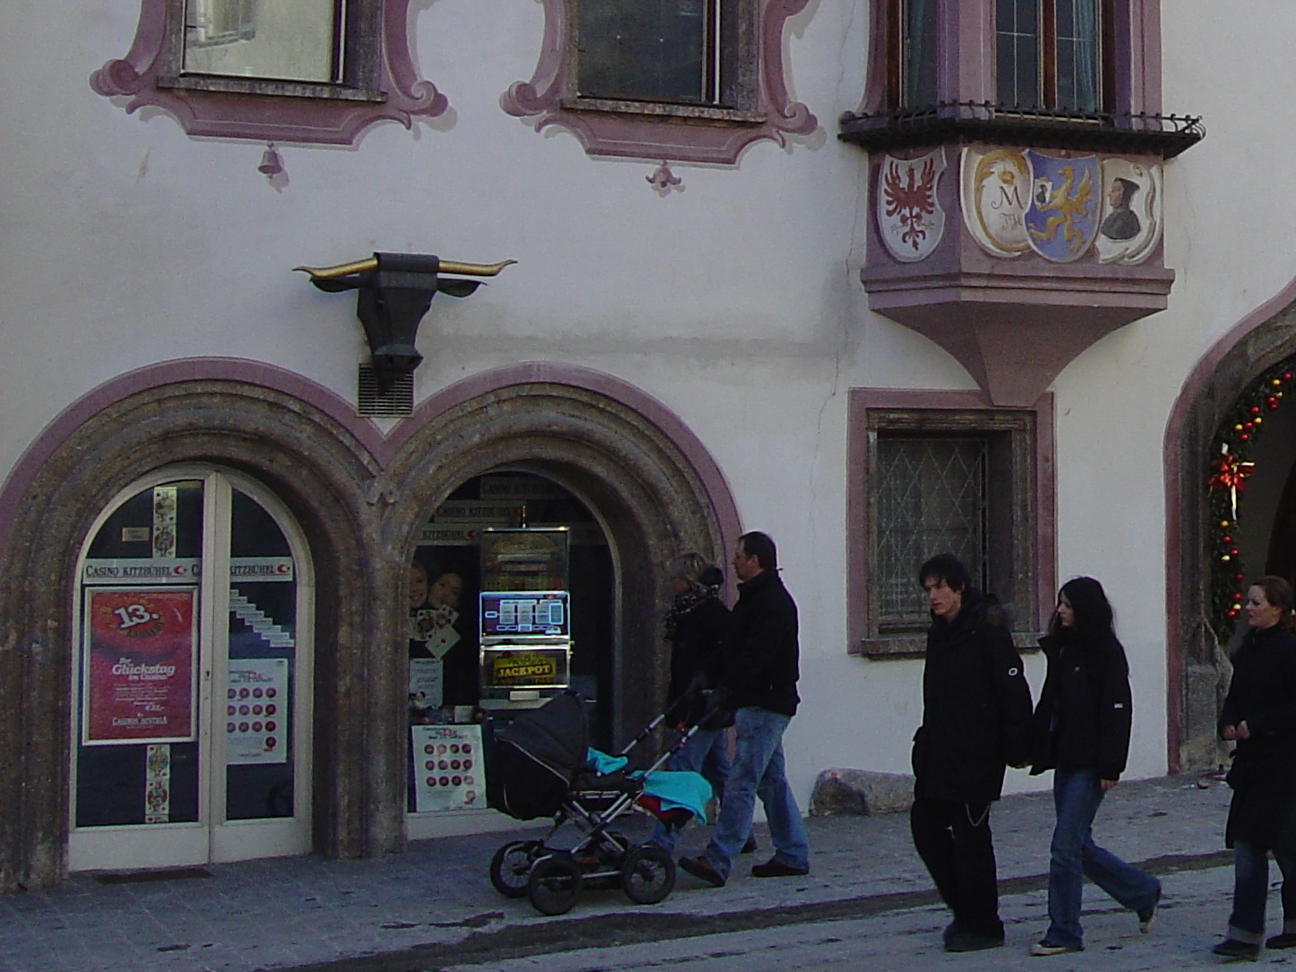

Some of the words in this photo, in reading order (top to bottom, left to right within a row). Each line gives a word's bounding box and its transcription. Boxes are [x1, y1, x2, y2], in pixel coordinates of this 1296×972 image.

[85, 564, 119, 576] CASINO
[114, 604, 160, 629] 13.
[112, 663, 176, 677] Glückstag
[498, 663, 551, 678] JACKPOT
